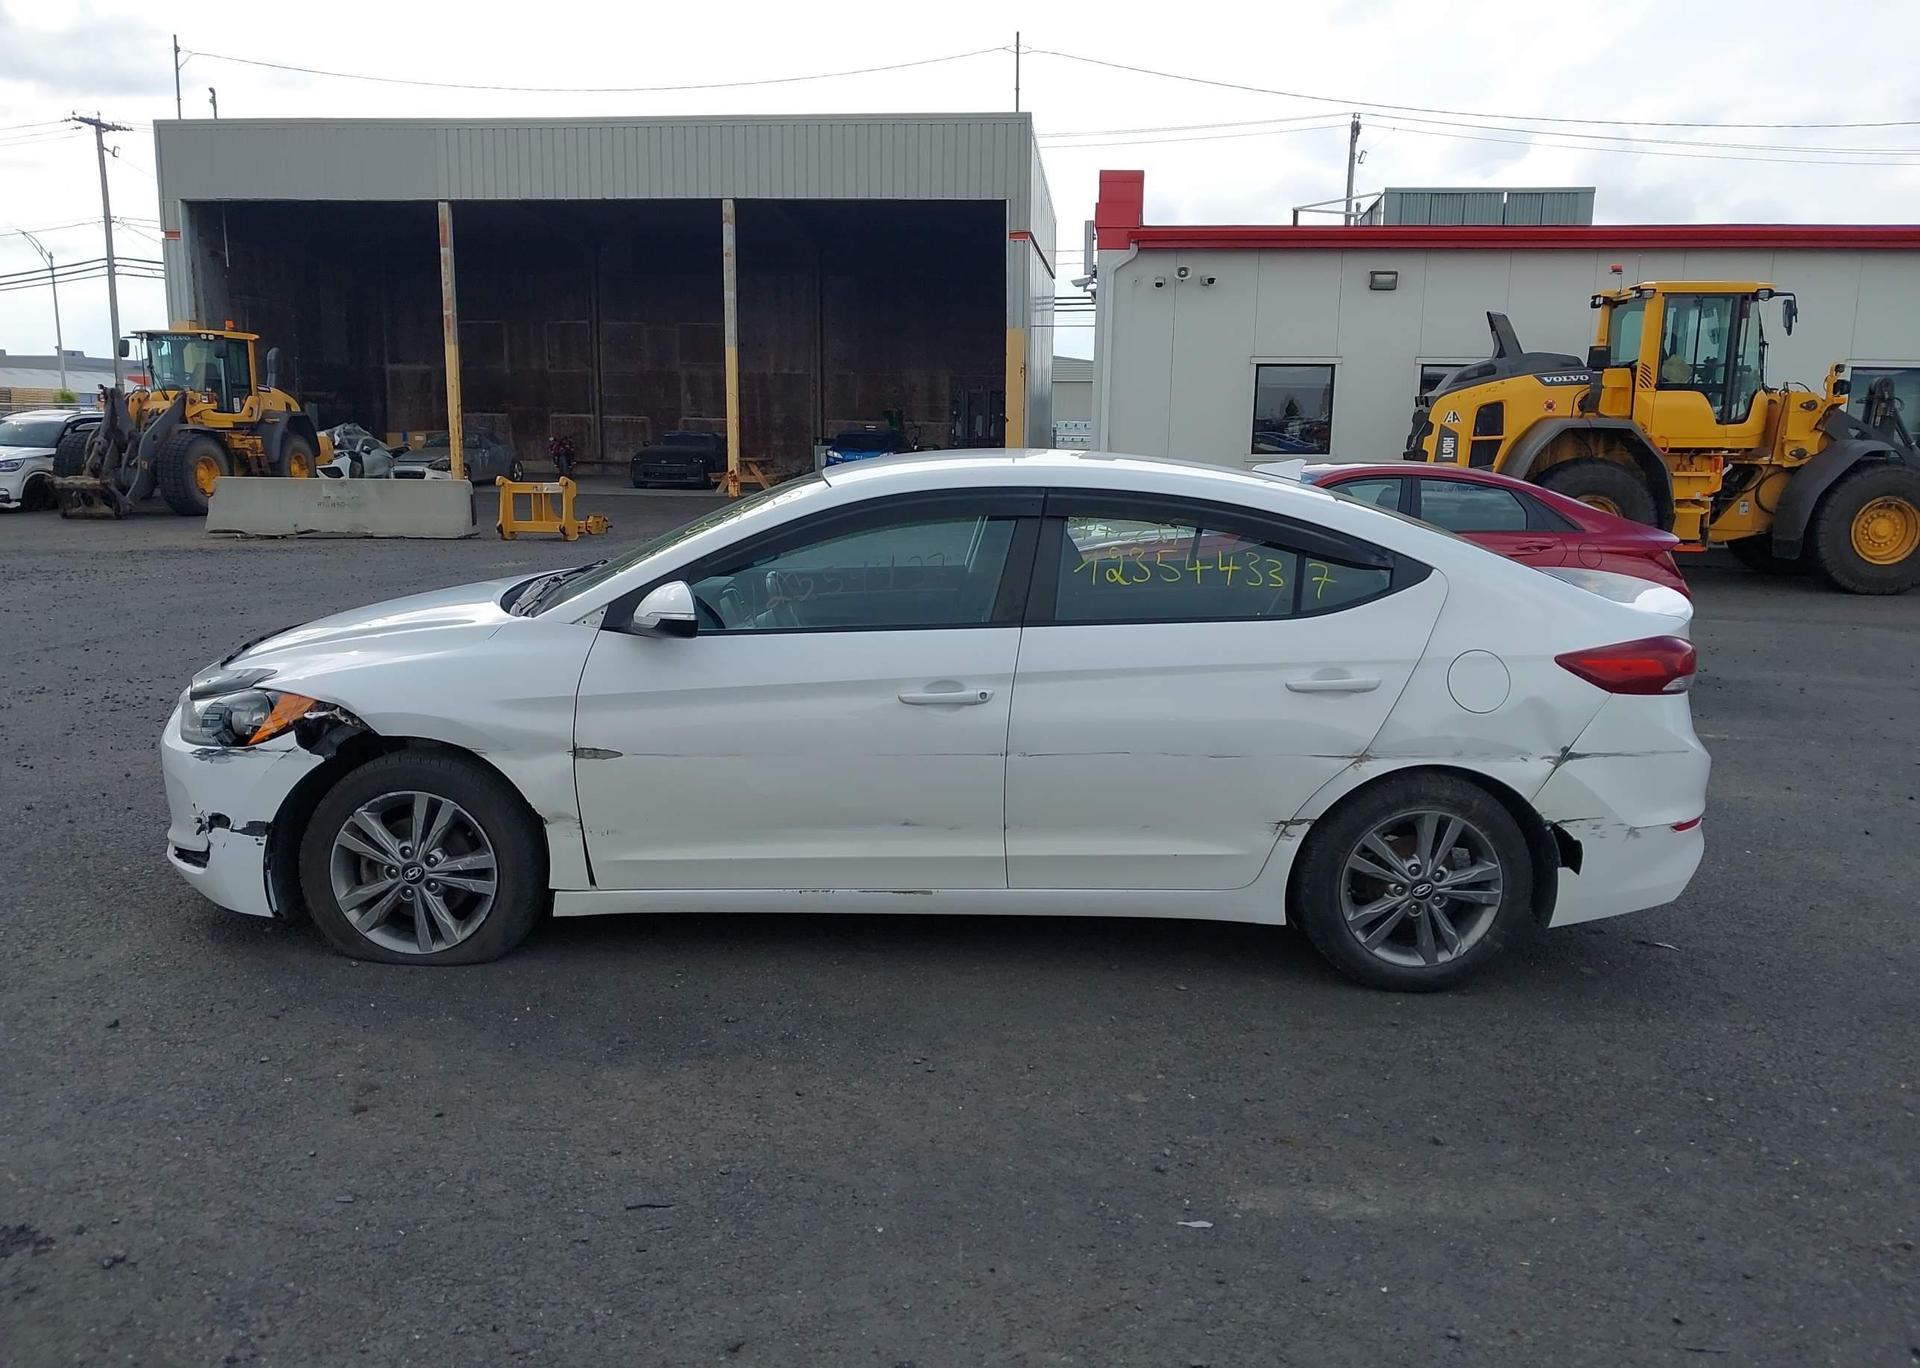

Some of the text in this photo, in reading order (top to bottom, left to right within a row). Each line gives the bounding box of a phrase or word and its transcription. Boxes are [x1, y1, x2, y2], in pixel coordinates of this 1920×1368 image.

[1543, 374, 1589, 383] VOLVO
[1442, 437, 1455, 458] L90H
[1074, 546, 1287, 587] 12354433
